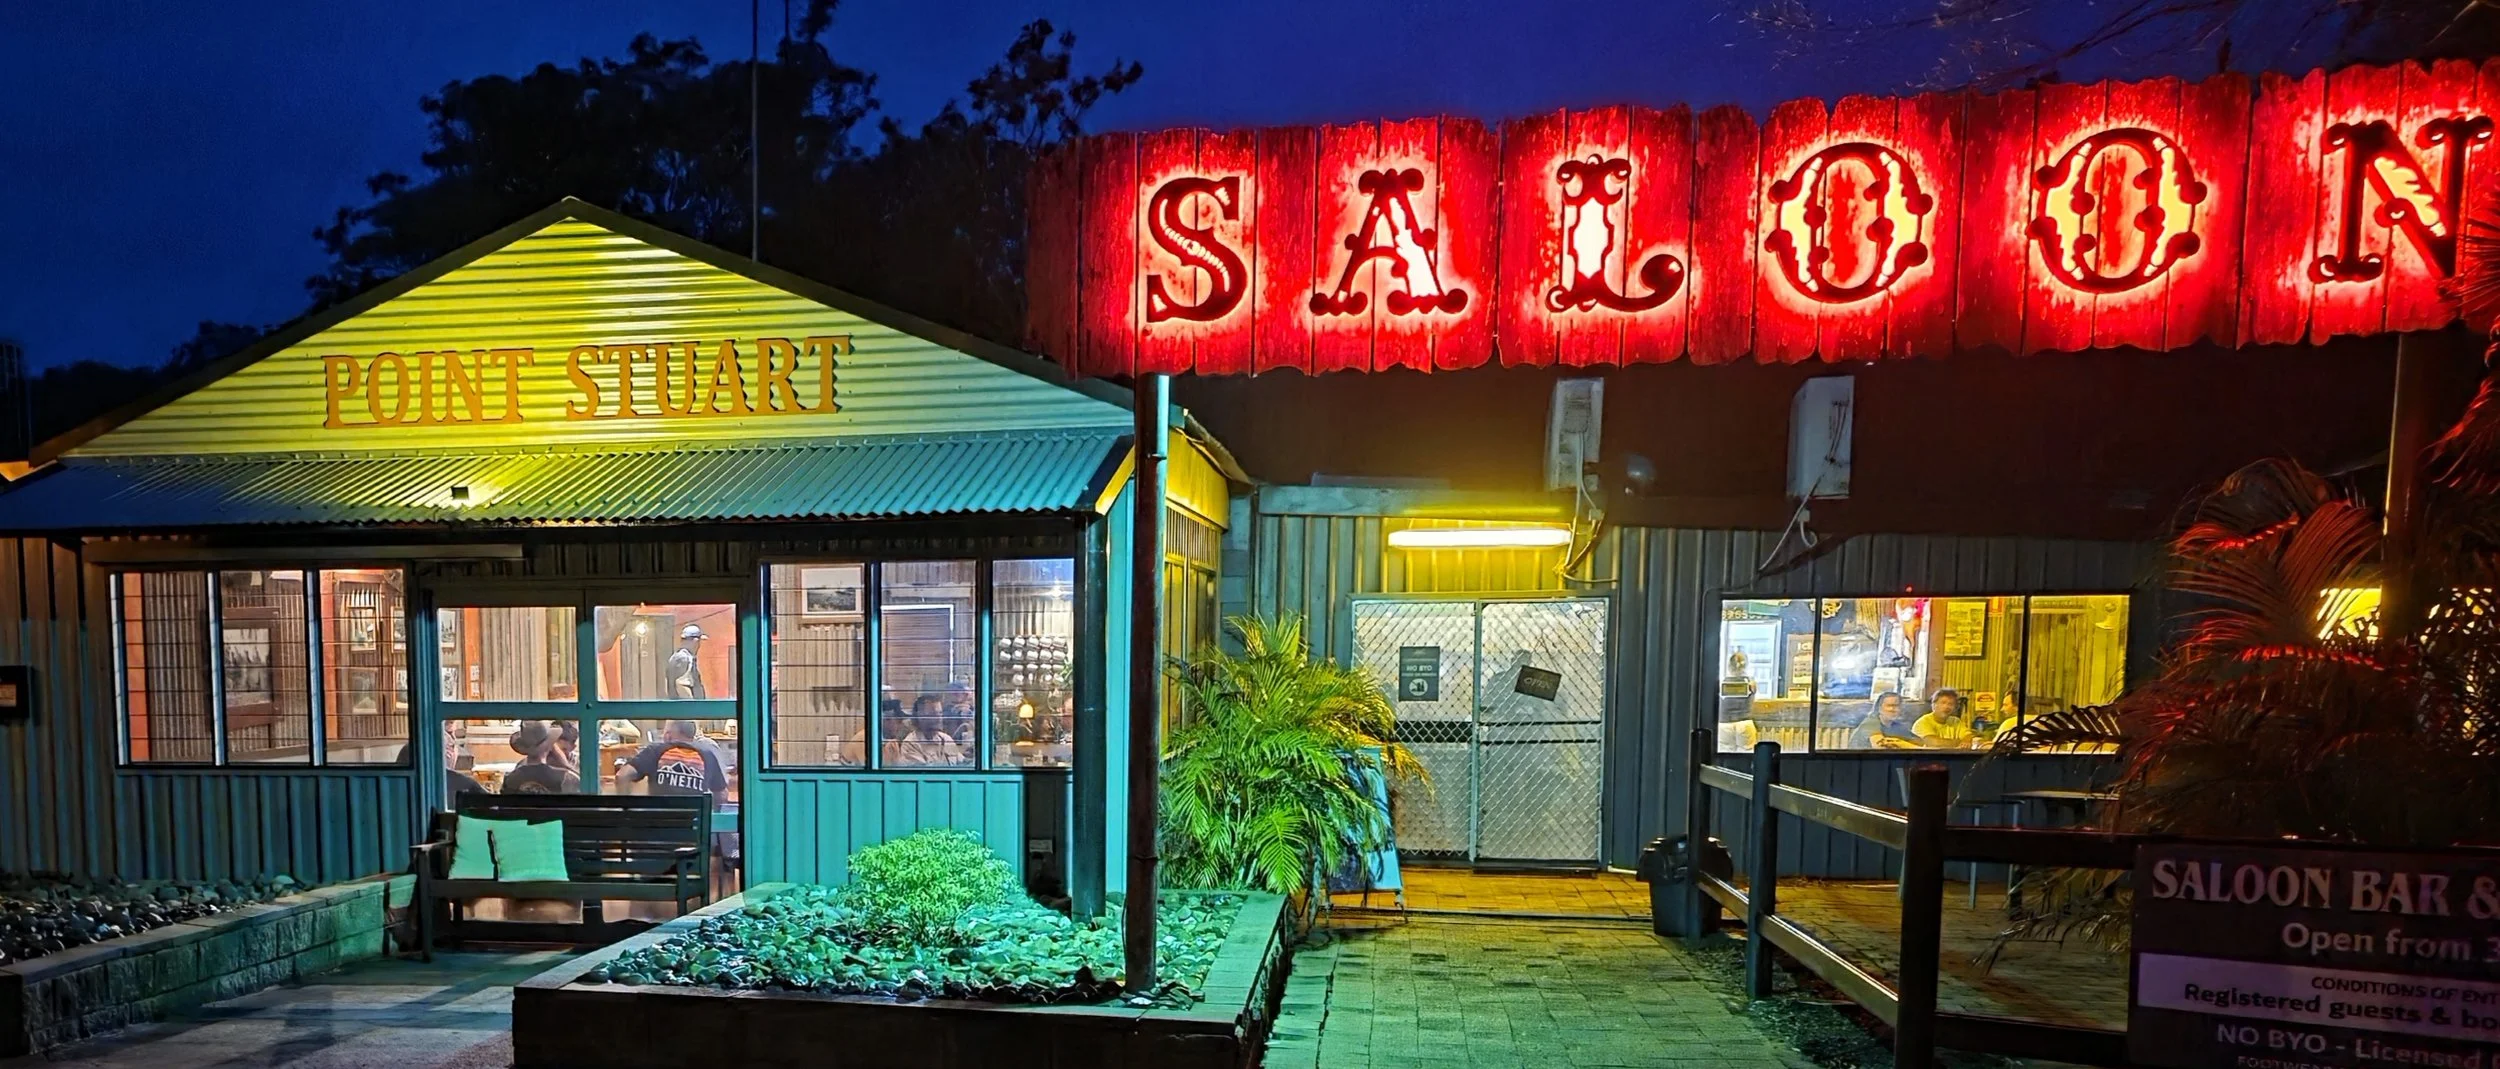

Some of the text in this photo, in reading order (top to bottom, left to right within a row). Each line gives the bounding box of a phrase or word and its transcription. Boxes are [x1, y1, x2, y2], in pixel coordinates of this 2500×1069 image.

[1146, 115, 2496, 321] SALOON
[321, 335, 853, 429] POINT STUART
[657, 772, 704, 792] O'NEILL
[2152, 859, 2332, 910] SALOON
[2349, 870, 2452, 917] BAR
[2281, 921, 2375, 956] Open
[2384, 928, 2472, 961] from
[2184, 983, 2321, 1013] Registered
[2328, 1001, 2423, 1023] guests
[2430, 1006, 2452, 1026] &
[2311, 975, 2427, 999] CONDITIONS
[2430, 986, 2458, 1001] OF
[2217, 1023, 2260, 1046] NO
[2267, 1028, 2328, 1055] BYO
[2355, 1037, 2482, 1069] Licensed
